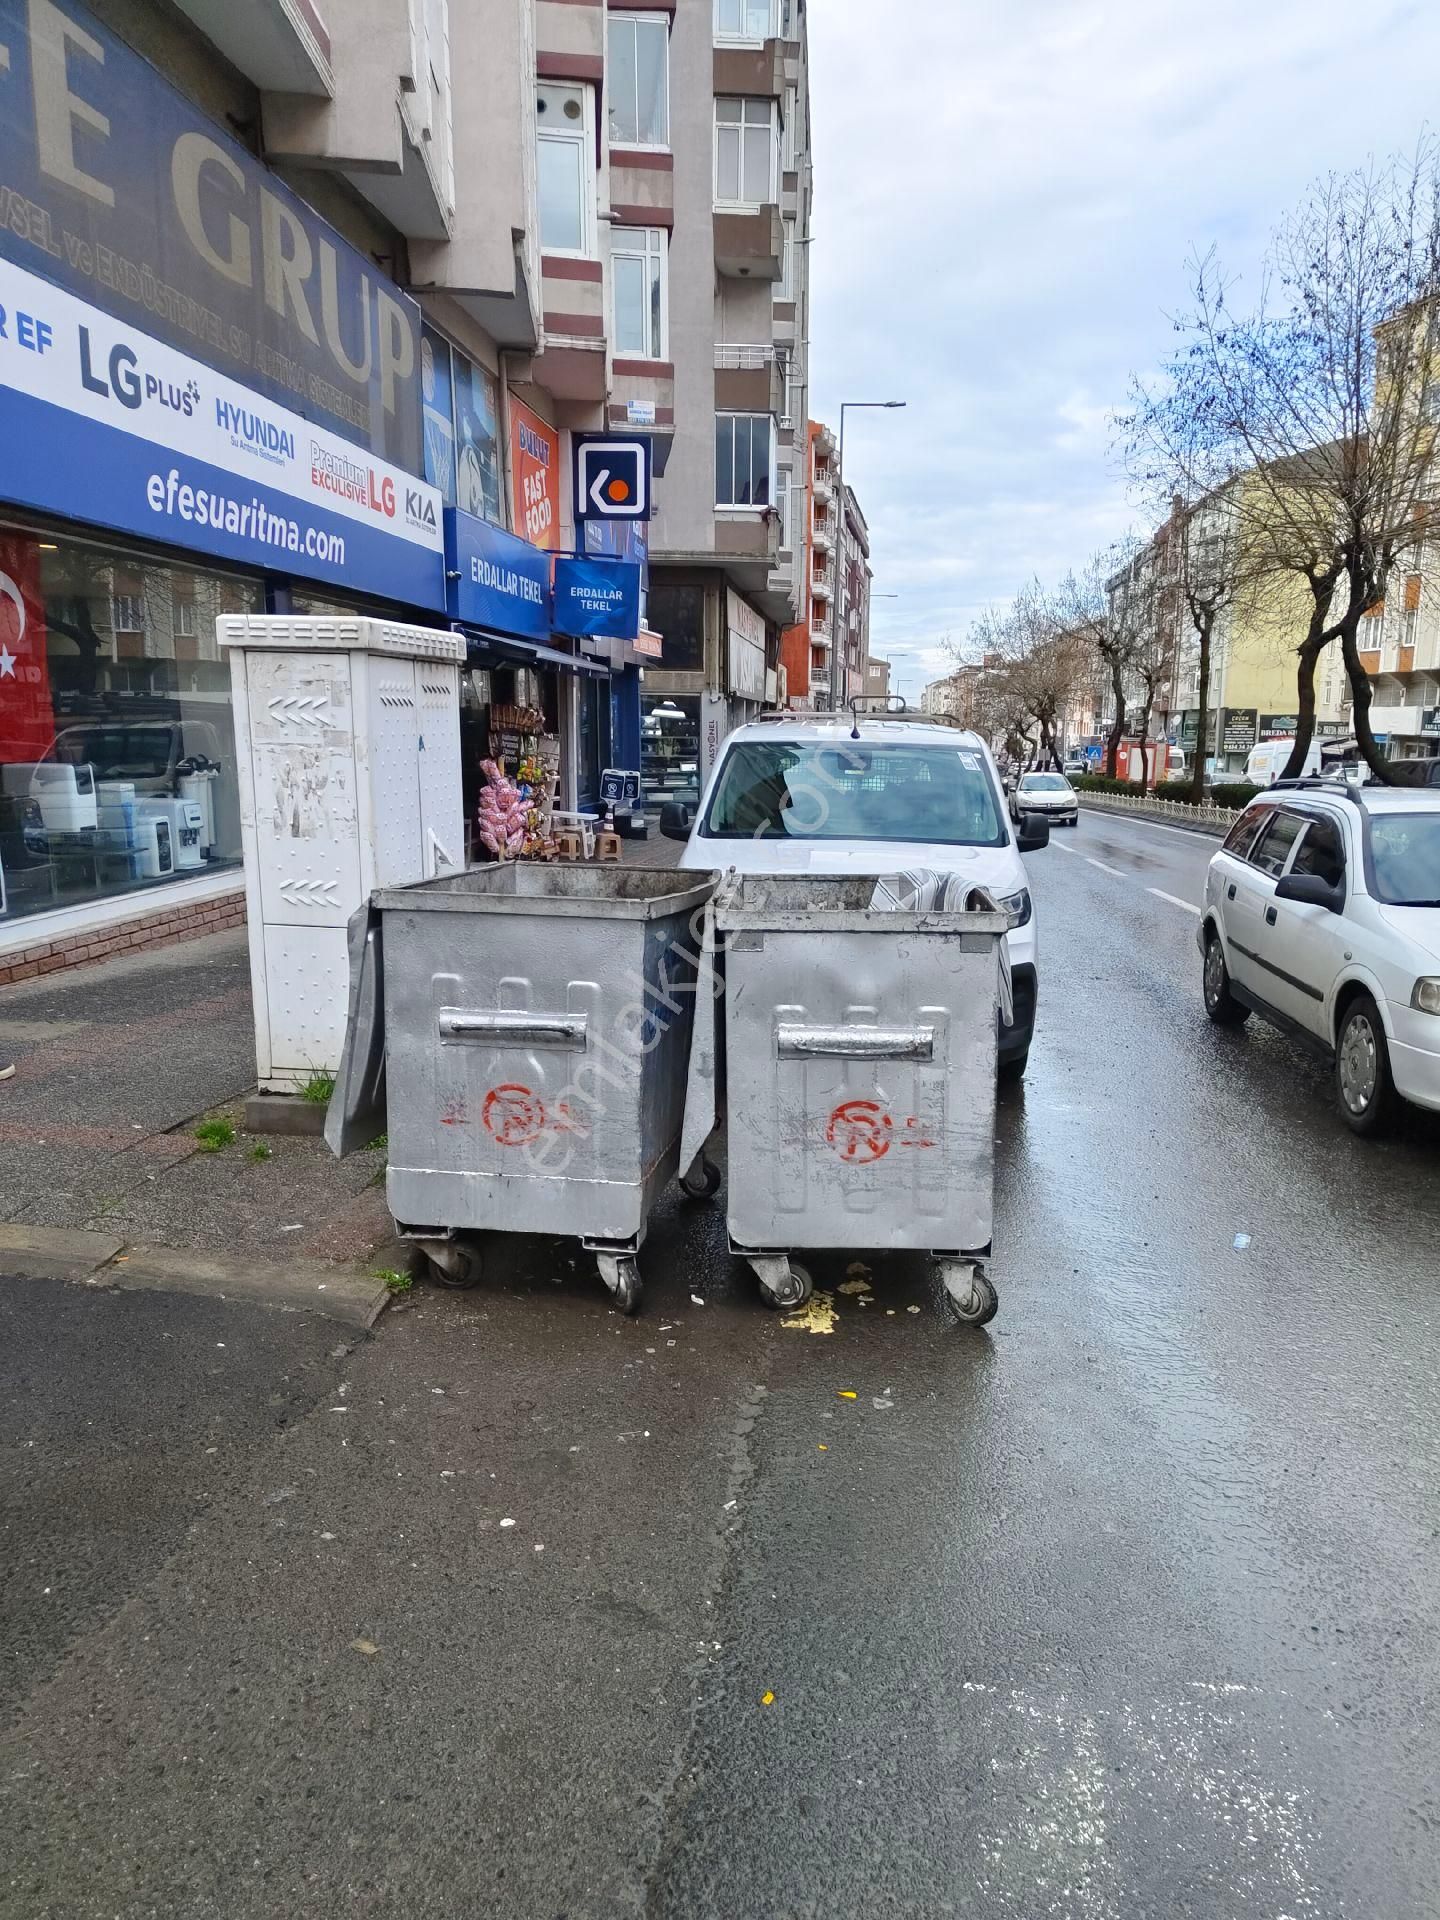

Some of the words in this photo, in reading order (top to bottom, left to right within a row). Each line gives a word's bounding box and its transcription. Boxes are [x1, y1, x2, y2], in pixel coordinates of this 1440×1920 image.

[171, 131, 416, 416] GRUP
[78, 325, 143, 409] LG
[215, 397, 295, 460] HYUNDAI
[310, 439, 366, 489] Premium
[311, 466, 368, 506] EXCULISIVE
[523, 468, 547, 507] FAST
[147, 469, 345, 565] efesuaritma.com
[368, 468, 396, 518] LG
[405, 487, 437, 527] KIA
[525, 497, 552, 541] FOOD
[471, 556, 518, 597] ERDALLAR
[519, 576, 544, 605] TEKEL
[570, 586, 623, 601] ERDALLAR
[580, 599, 612, 612] TEKEL
